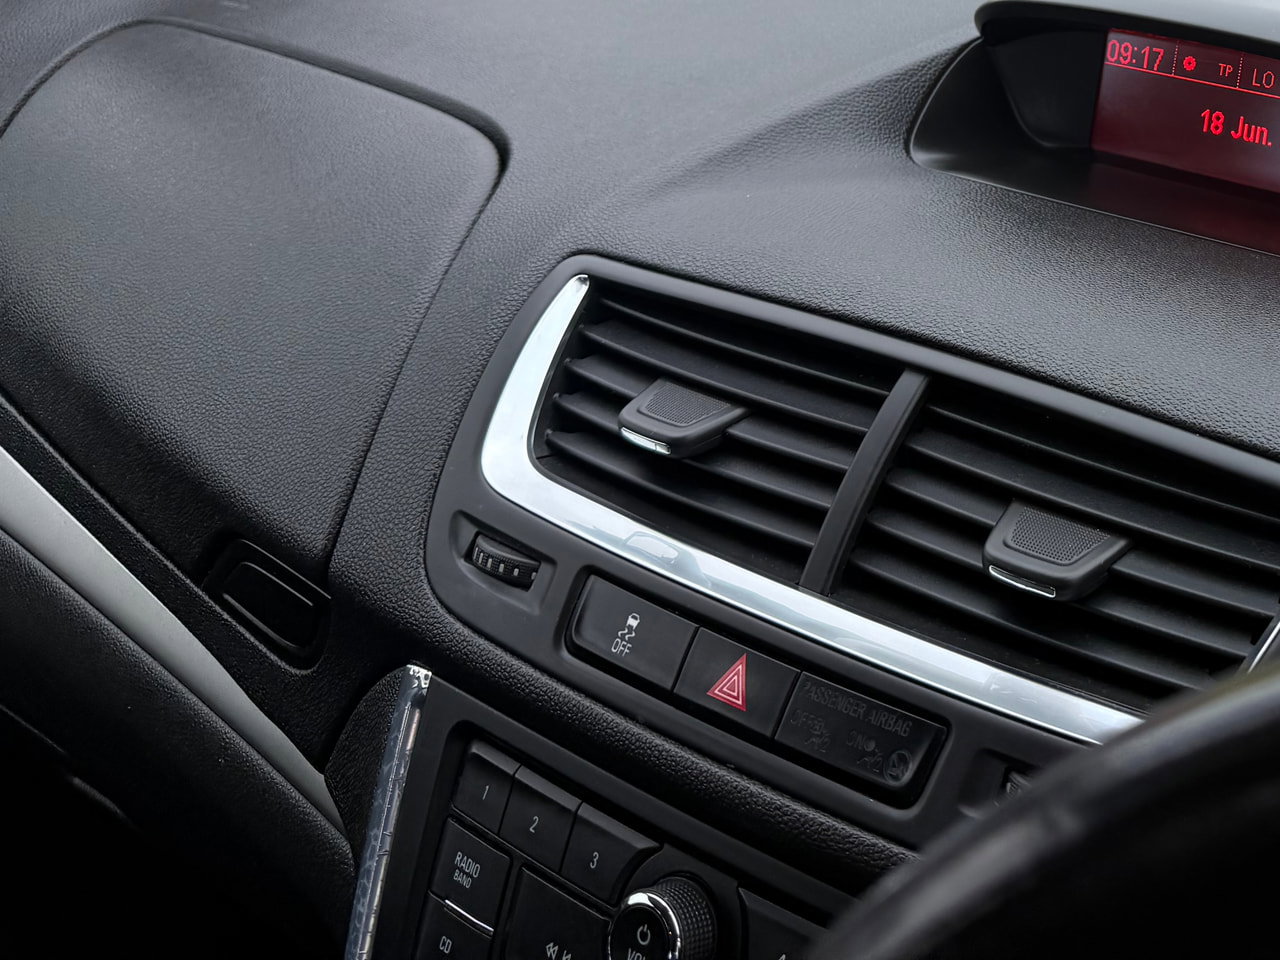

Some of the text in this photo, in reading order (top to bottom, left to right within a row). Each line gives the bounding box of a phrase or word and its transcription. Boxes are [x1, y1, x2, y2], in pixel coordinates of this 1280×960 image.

[1106, 40, 1164, 72] 09:17
[1218, 62, 1234, 77] TP
[1251, 68, 1275, 89] LO
[1200, 108, 1226, 136] 18
[1230, 115, 1273, 147] Jun.
[611, 638, 633, 658] OFF
[864, 709, 913, 738] AIRBAG
[481, 784, 491, 801] 1
[529, 815, 541, 834] 2
[453, 850, 482, 880] RADIO
[589, 850, 600, 871] 3
[452, 870, 473, 890] BAND
[438, 934, 454, 956] CD
